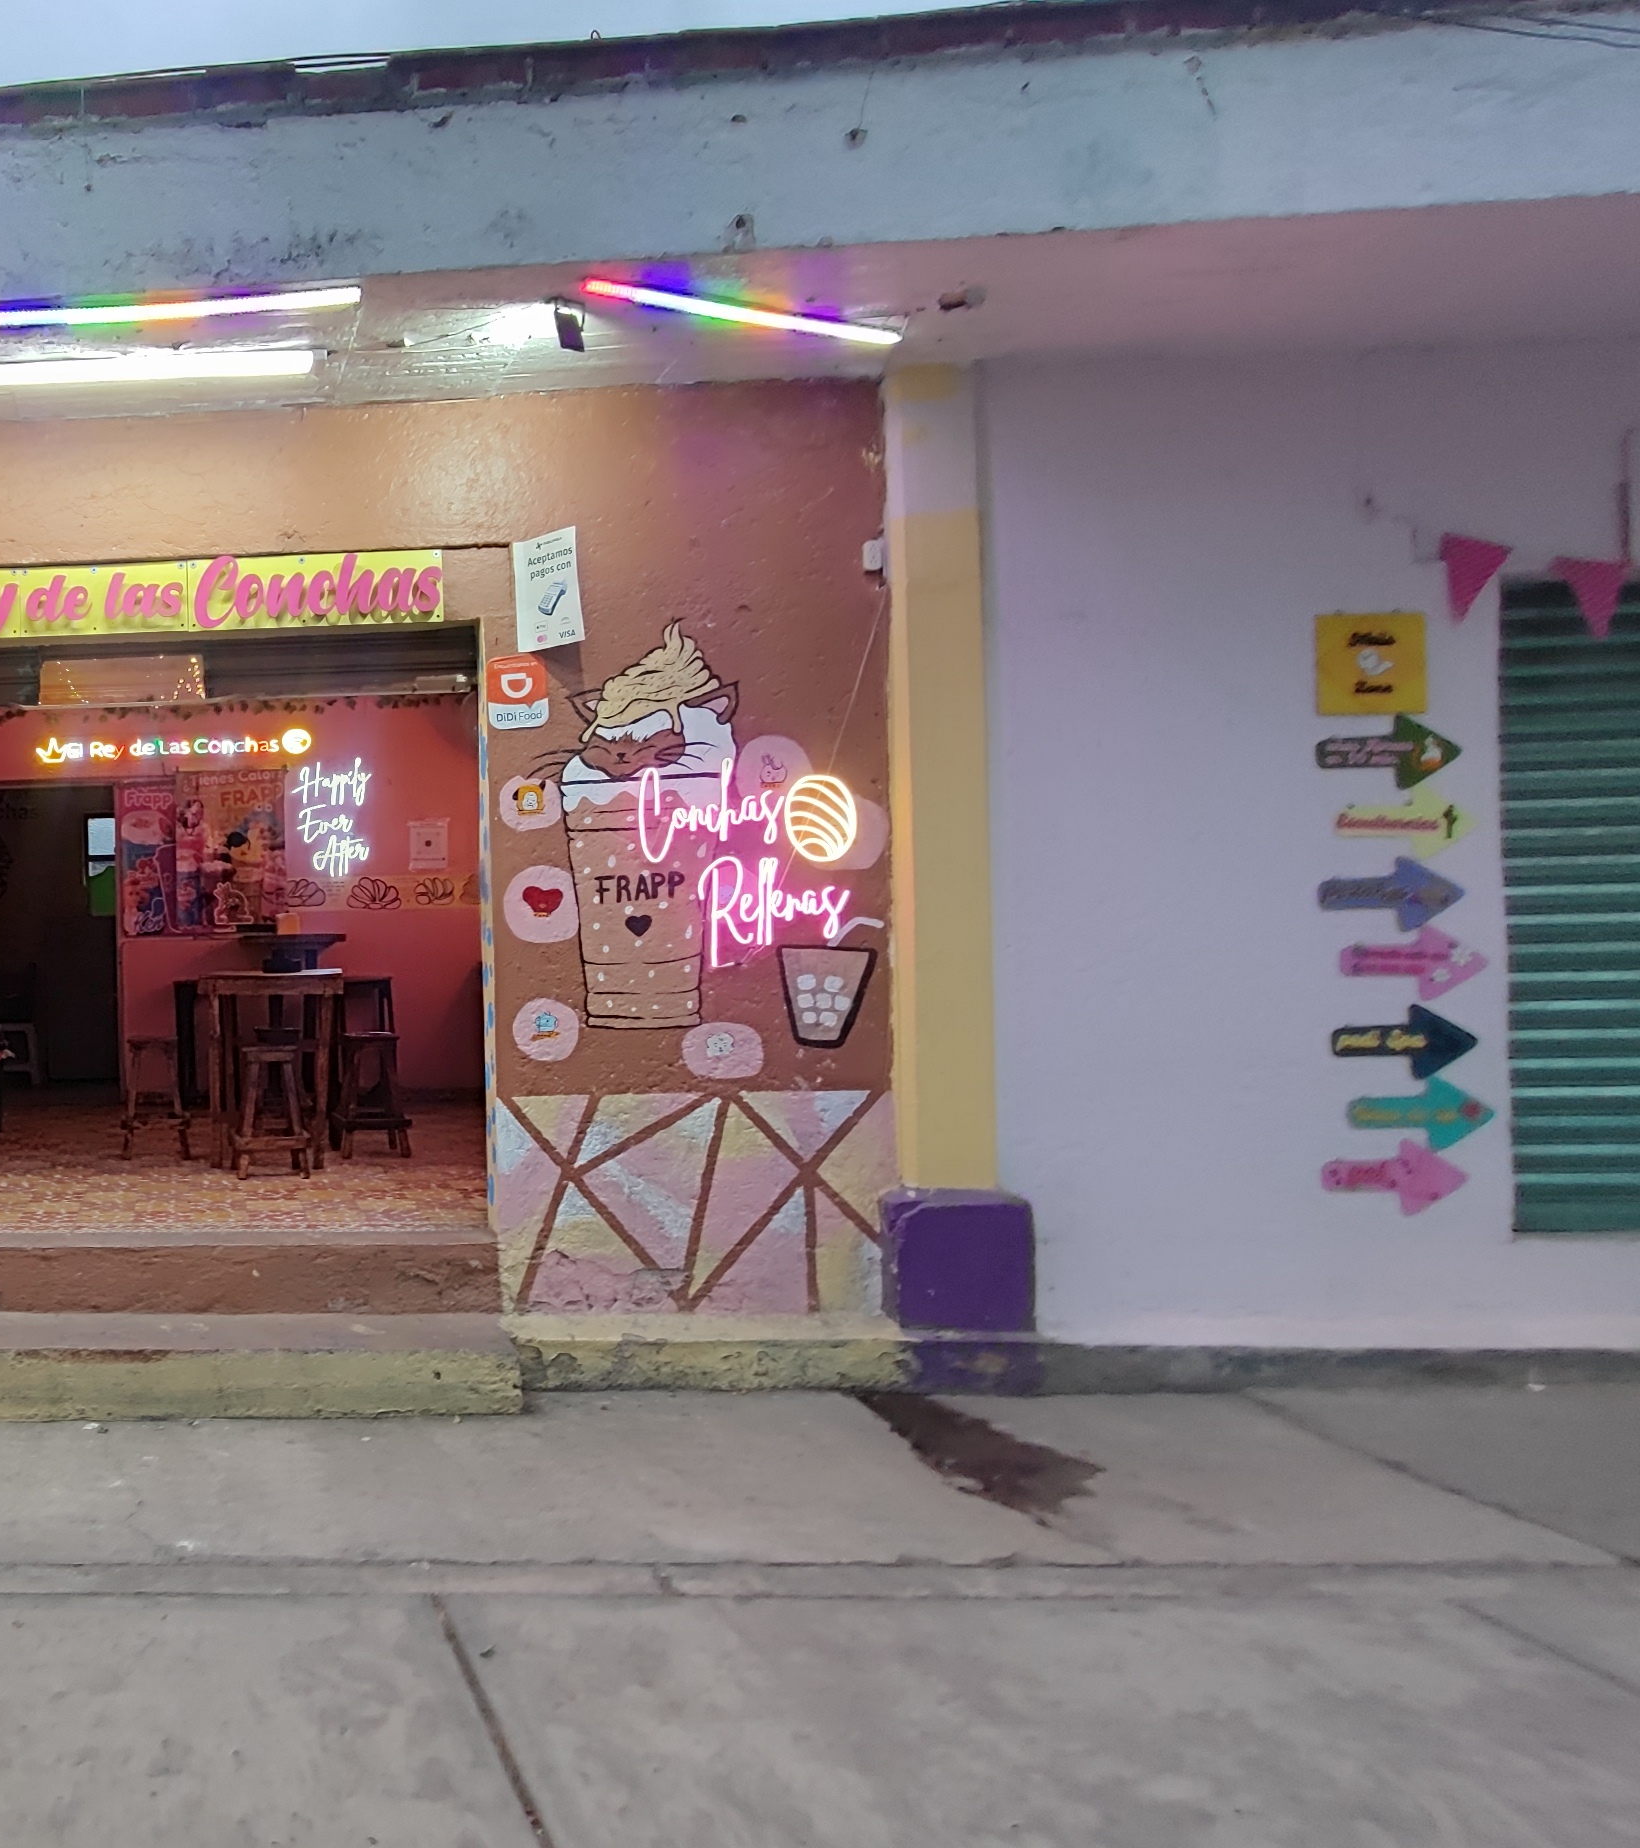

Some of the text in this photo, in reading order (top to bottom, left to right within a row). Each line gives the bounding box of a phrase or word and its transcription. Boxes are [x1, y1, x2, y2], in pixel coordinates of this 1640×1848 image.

[527, 546, 573, 567] Aceptamos
[530, 560, 572, 581] pagos con
[26, 574, 93, 622] de
[104, 571, 184, 620] las
[194, 553, 443, 629] Conchas
[559, 629, 576, 639] VISA
[496, 709, 543, 722] DiDi Food
[89, 741, 125, 761] Rey
[193, 735, 280, 755] Conchas
[291, 757, 372, 806] Happily
[123, 788, 174, 810] Frapp
[638, 757, 786, 864] Conchas
[296, 803, 353, 843] Ever
[313, 834, 370, 877] After
[594, 872, 686, 905] FRAPP
